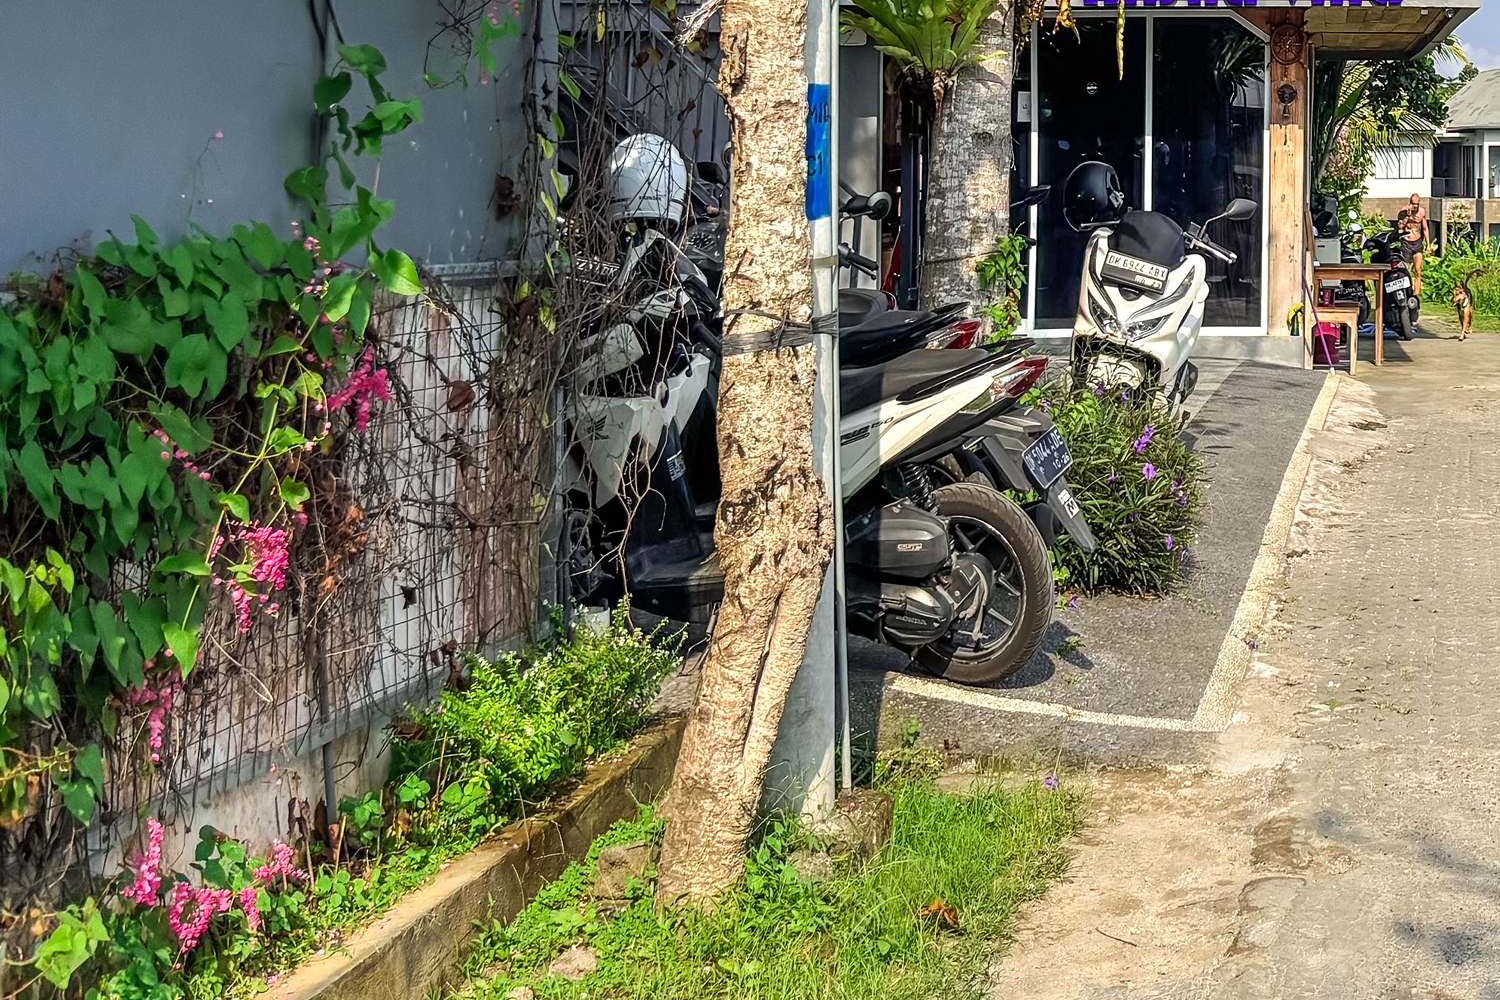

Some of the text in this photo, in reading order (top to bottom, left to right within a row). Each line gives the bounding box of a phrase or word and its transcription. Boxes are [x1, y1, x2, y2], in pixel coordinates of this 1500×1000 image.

[1108, 255, 1121, 265] DK
[1123, 259, 1145, 272] 6944
[871, 416, 894, 429] 150
[1031, 440, 1051, 464] 5044
